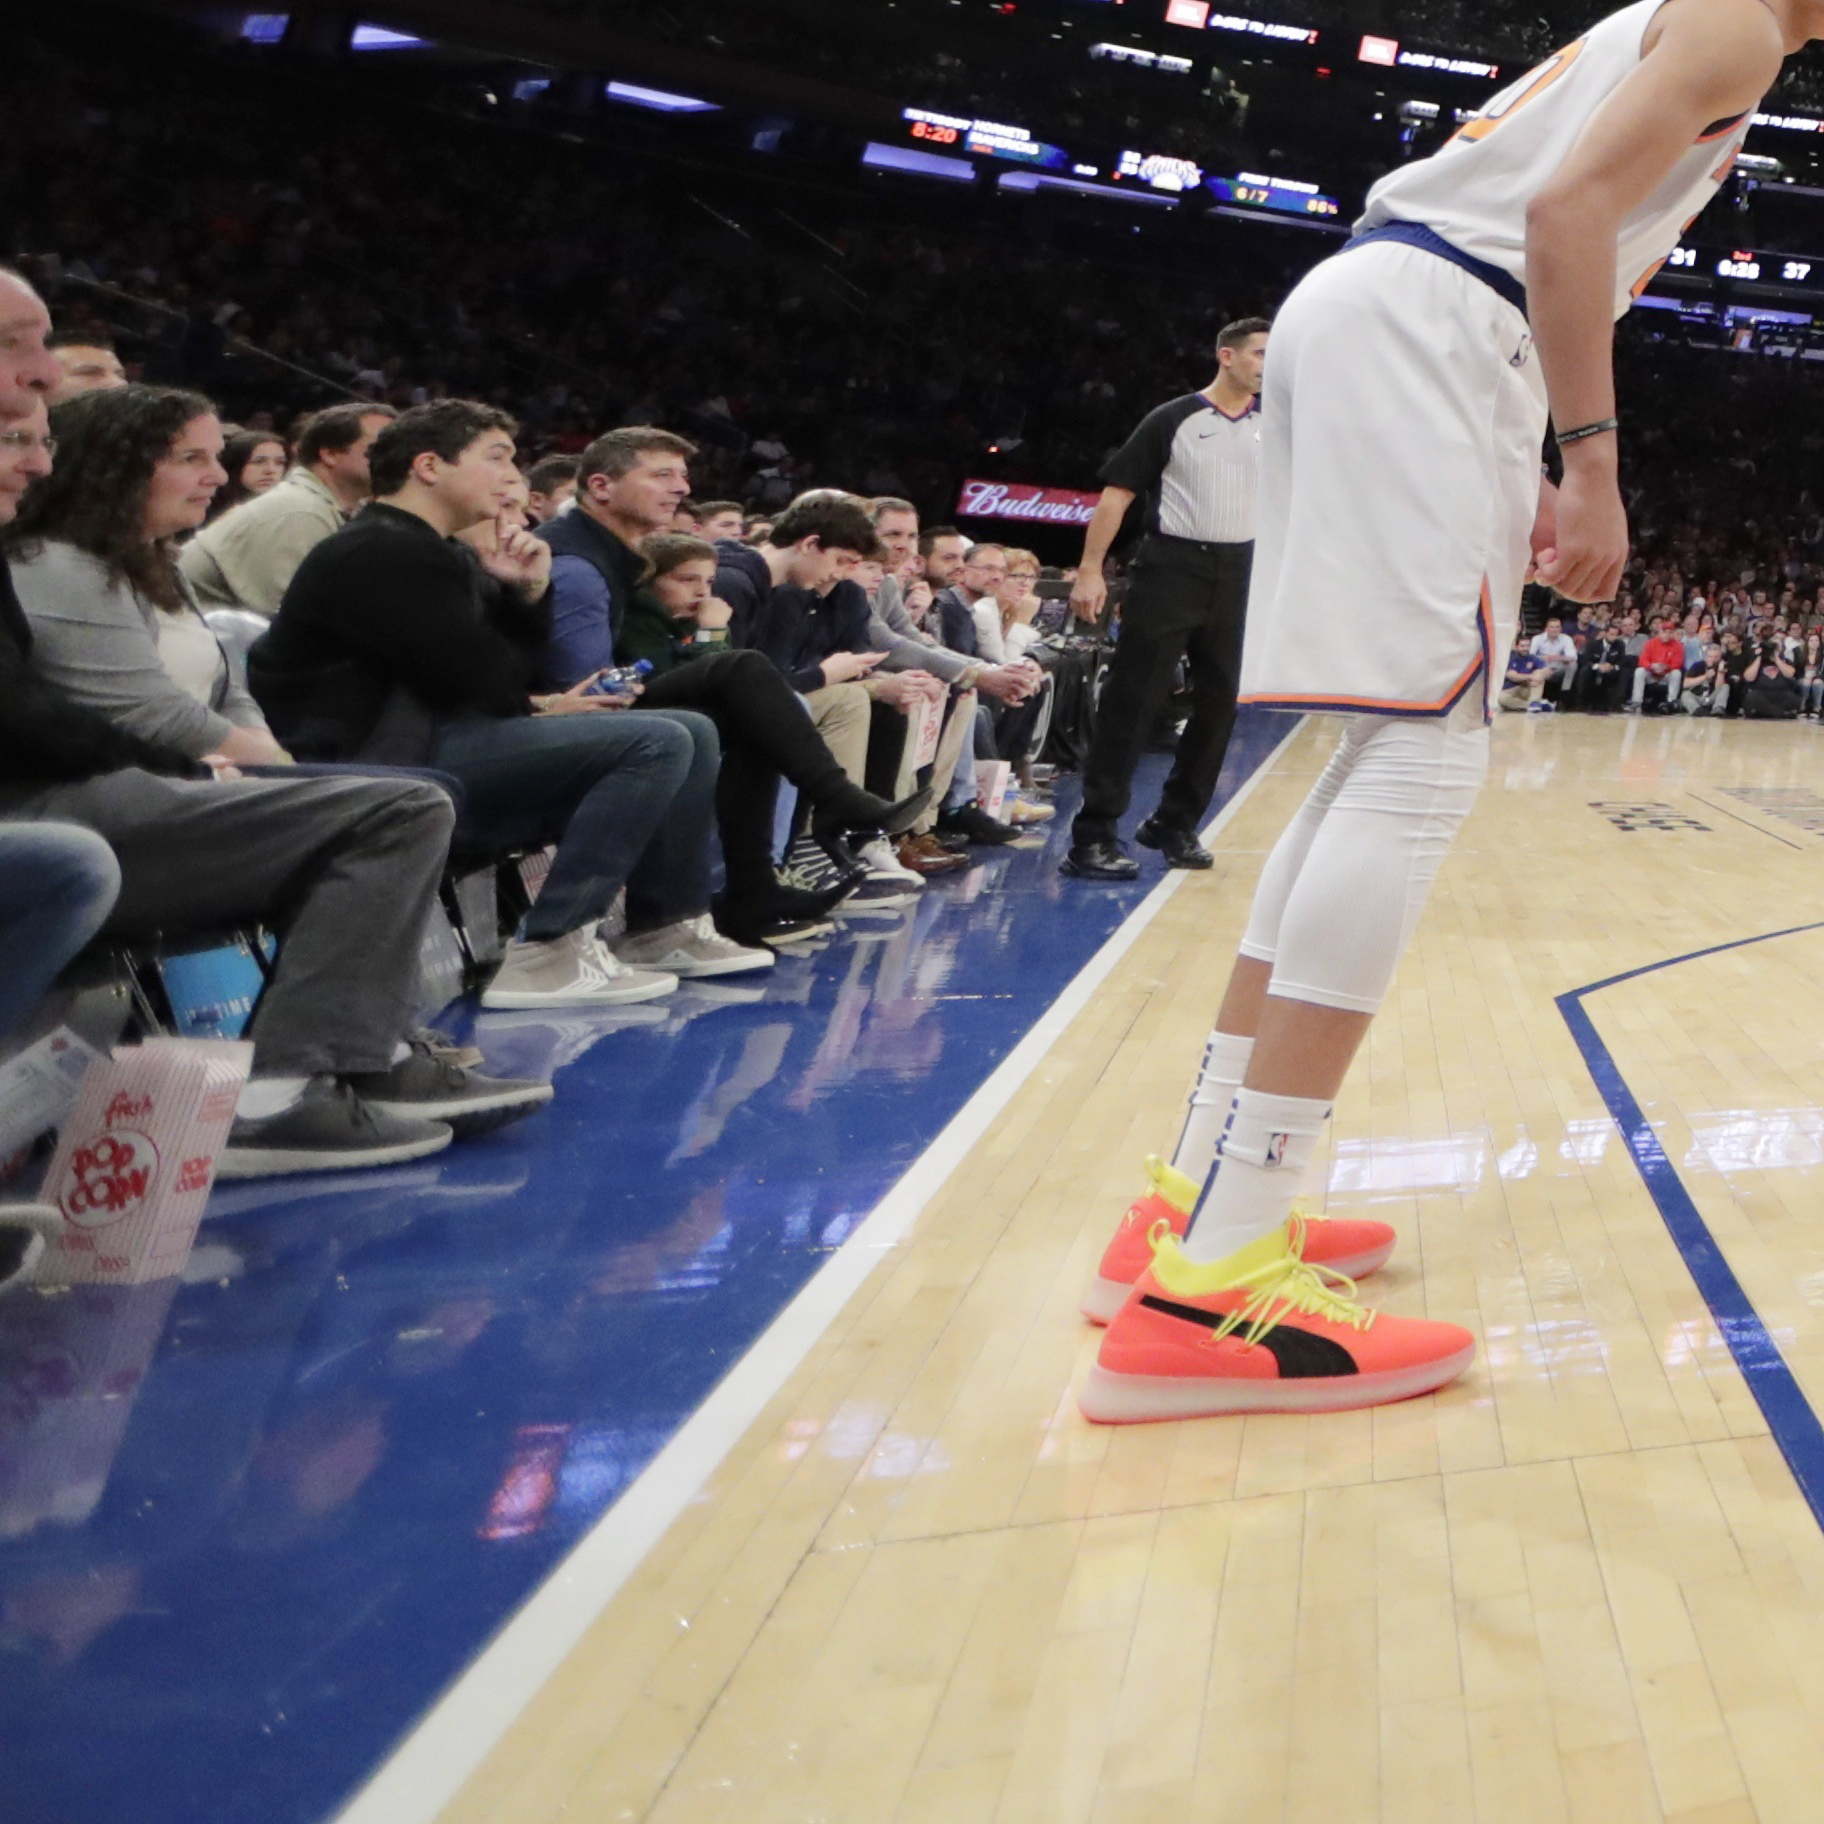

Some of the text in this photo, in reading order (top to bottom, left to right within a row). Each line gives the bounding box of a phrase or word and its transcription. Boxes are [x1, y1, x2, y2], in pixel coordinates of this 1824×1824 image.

[911, 121, 958, 143] 8:20
[1306, 199, 1339, 215] 86%
[1668, 246, 1696, 267] 31
[1717, 259, 1761, 279] 6:28
[1782, 261, 1811, 280] 37
[966, 482, 1095, 522] Budweise
